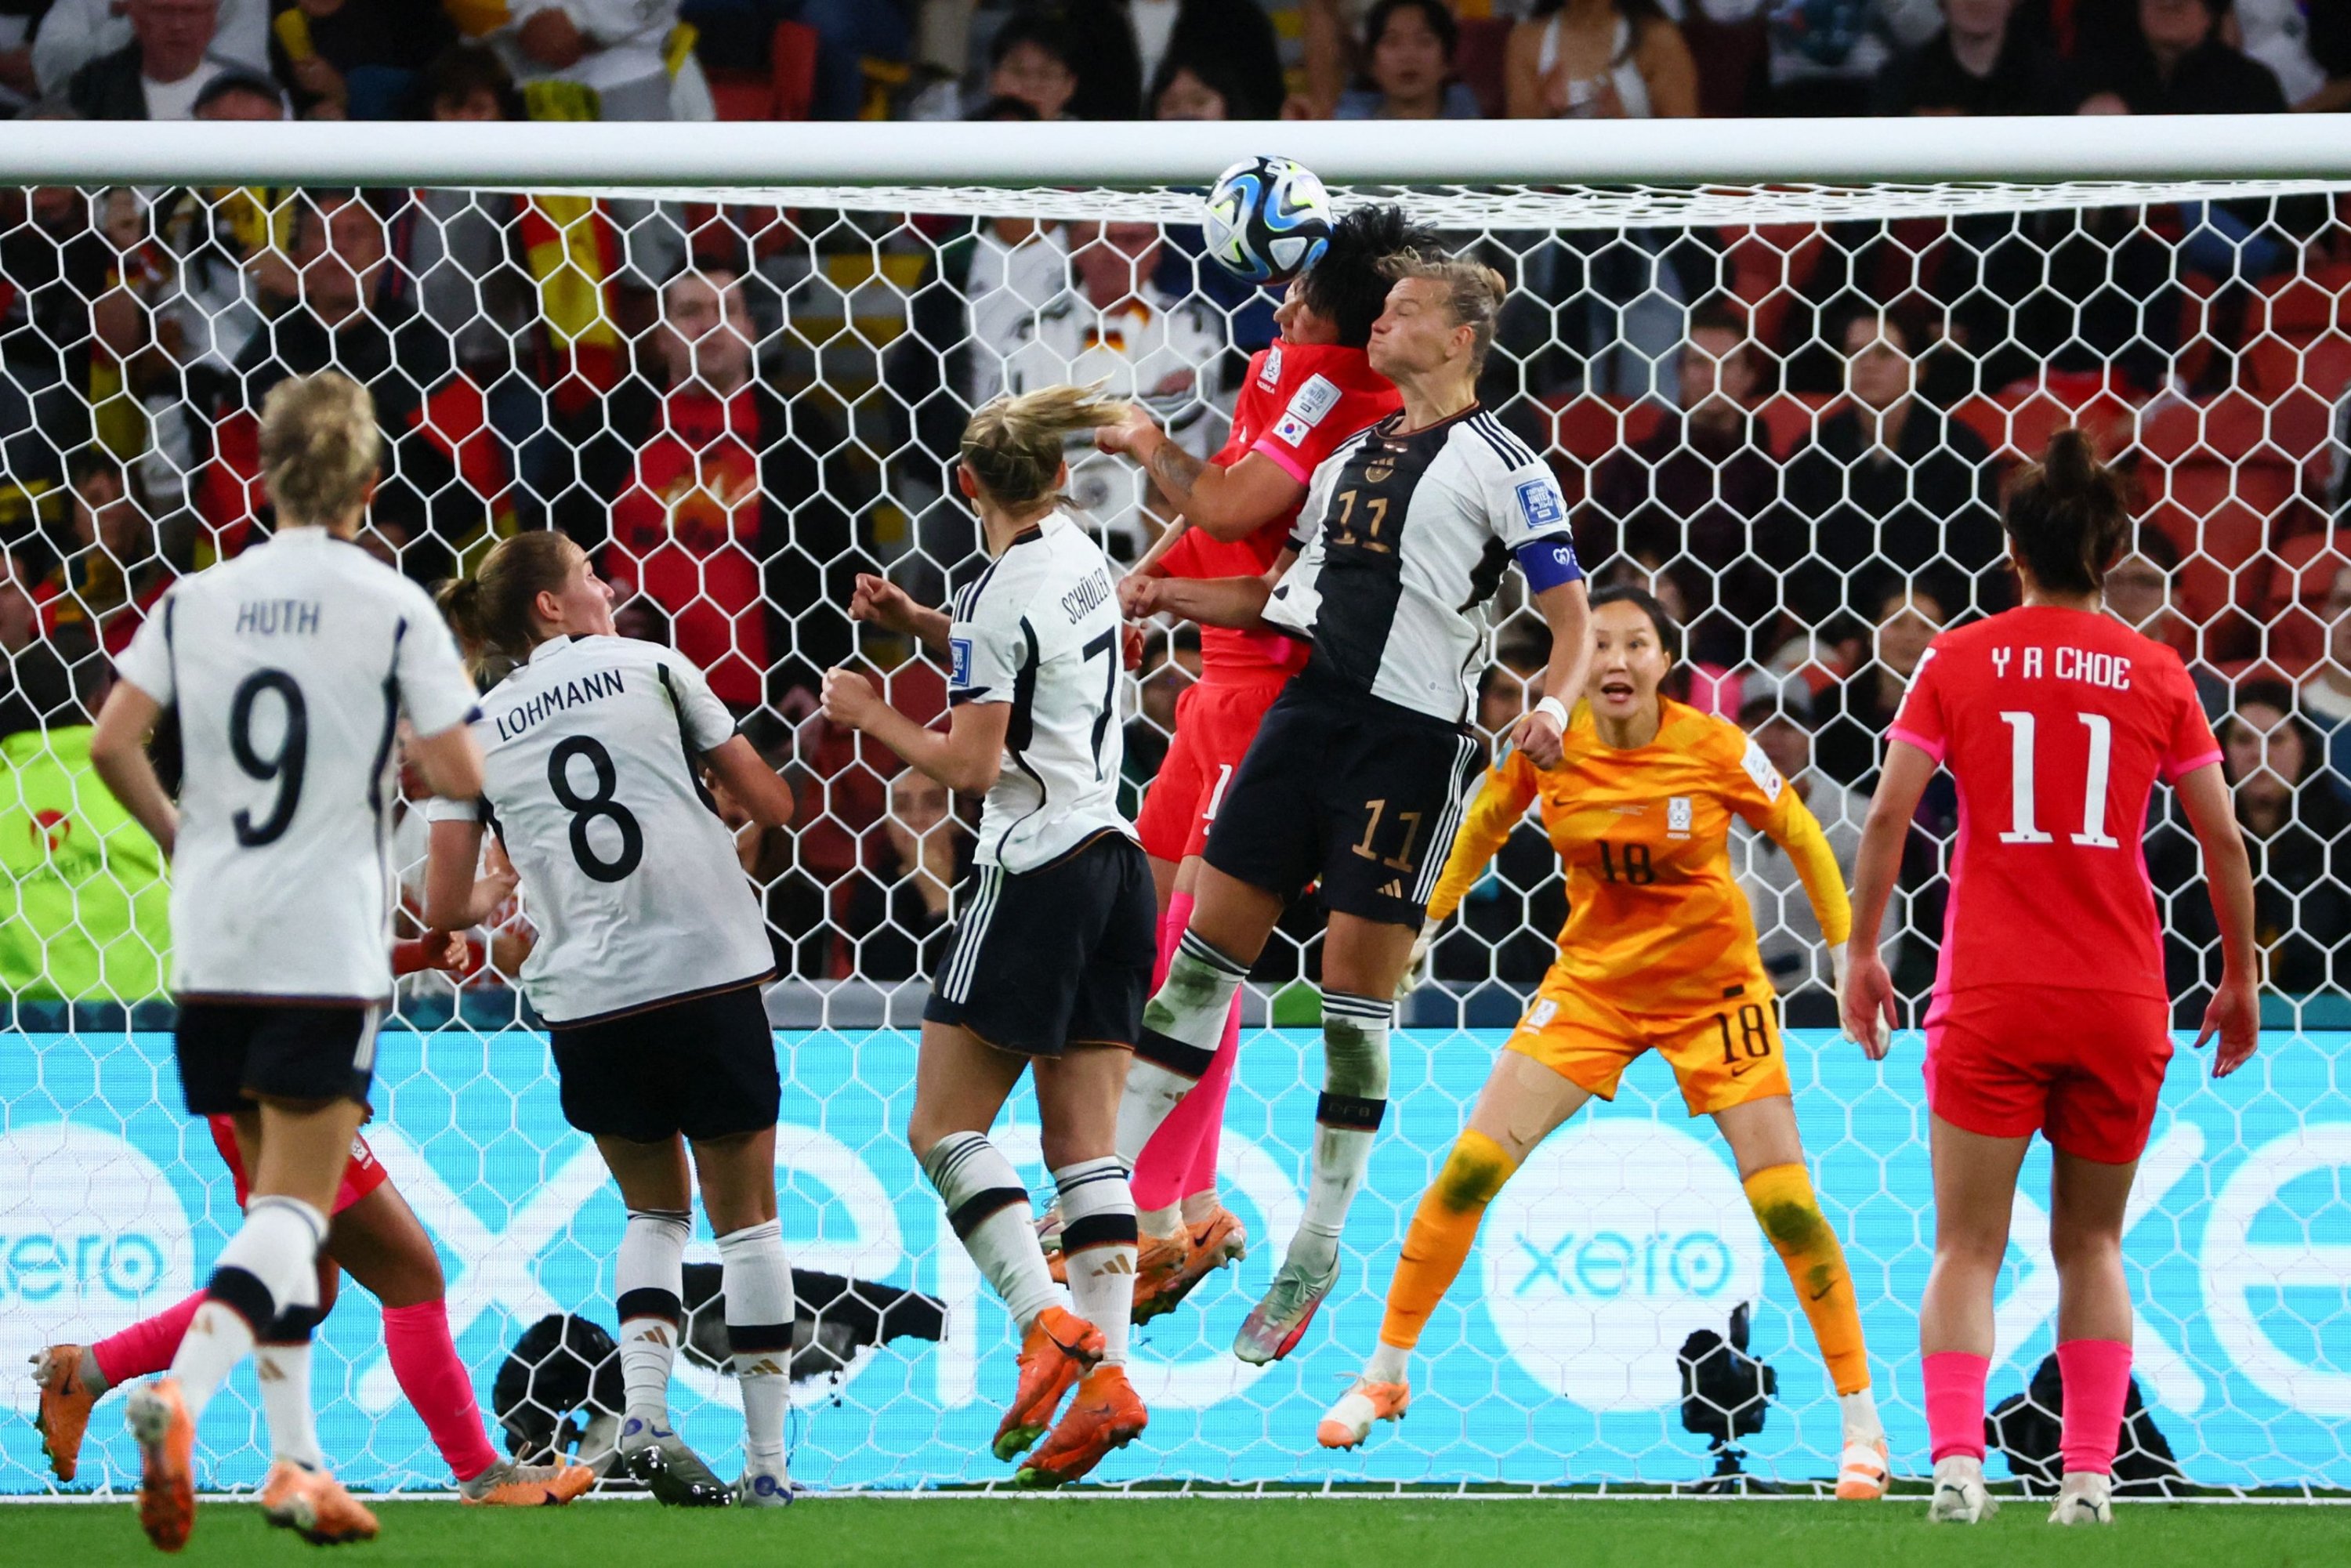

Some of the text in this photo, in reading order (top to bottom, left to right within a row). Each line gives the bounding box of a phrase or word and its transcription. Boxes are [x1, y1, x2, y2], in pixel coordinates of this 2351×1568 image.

[1333, 489, 1391, 553] 11
[236, 599, 320, 634] HUTH
[1082, 625, 1117, 783] 7
[1991, 646, 2011, 679] Y
[2055, 646, 2132, 691] CHOE
[496, 668, 625, 742] LOHMANN
[229, 667, 307, 847] 9
[1998, 711, 2120, 849] 11
[547, 734, 643, 883] 8
[1352, 798, 1422, 874] 11
[1596, 838, 1656, 885] 18
[1715, 1004, 1770, 1064] 18
[1513, 1230, 1734, 1298] xero
